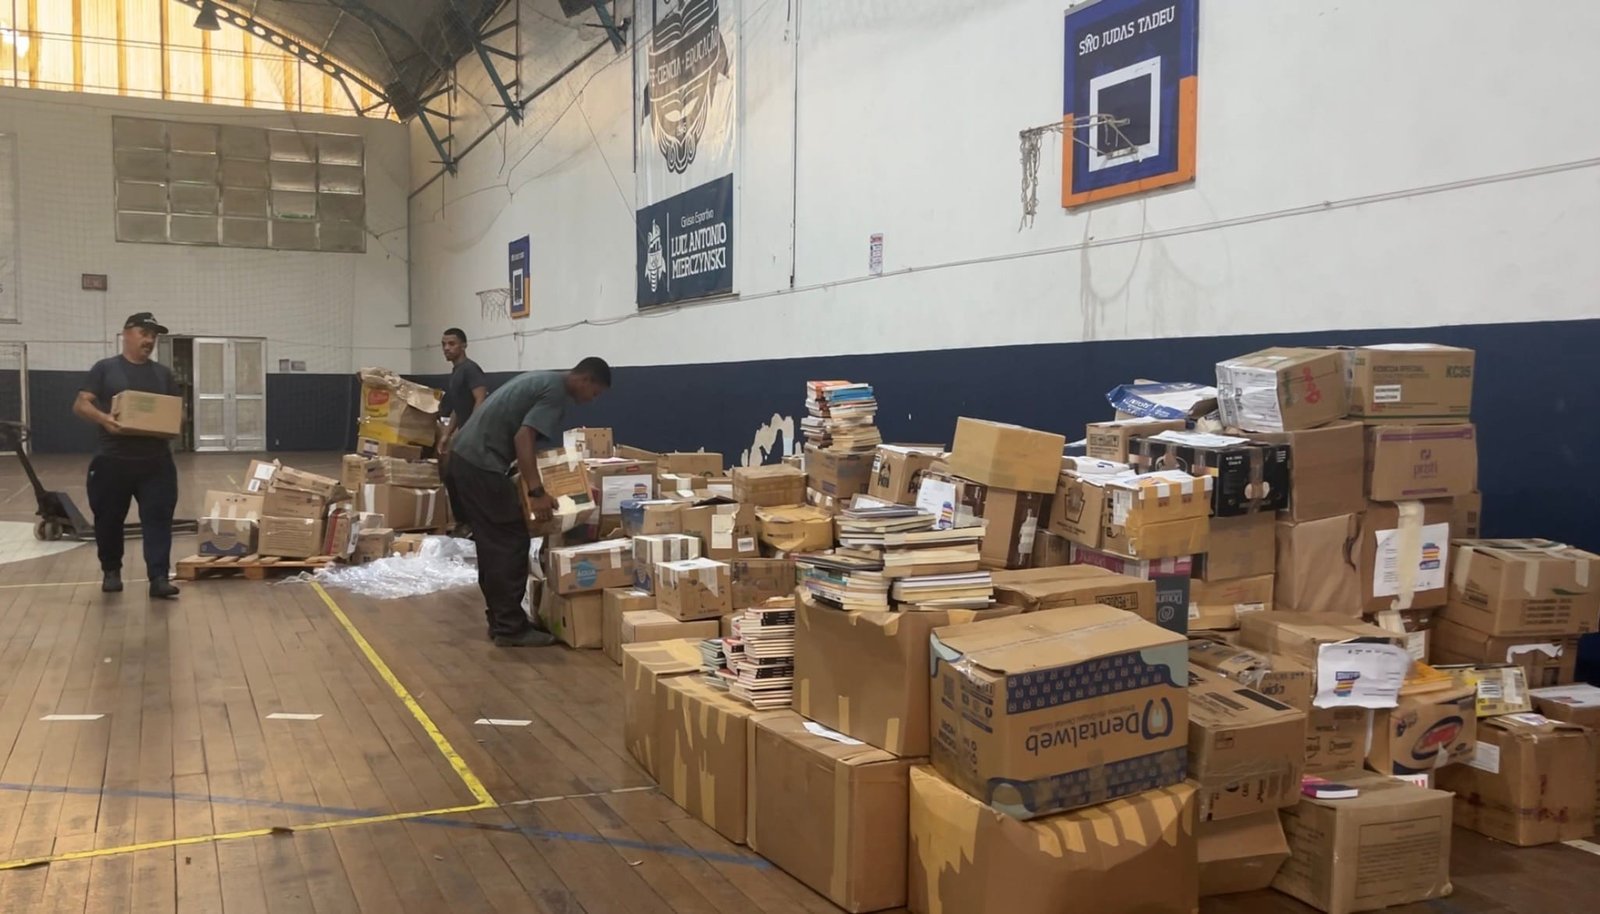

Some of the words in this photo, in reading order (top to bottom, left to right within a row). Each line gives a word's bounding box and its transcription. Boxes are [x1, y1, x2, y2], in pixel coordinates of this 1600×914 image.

[1101, 21, 1135, 48] JUDAS
[1137, 5, 1175, 34] TADEU
[657, 58, 681, 85] CIÊNCIA
[686, 26, 719, 69] EDUCAÇÃO
[689, 222, 726, 252] ANTONIO
[672, 247, 727, 279] MIERCZYNSKI
[1025, 711, 1141, 757] Dentalweb
